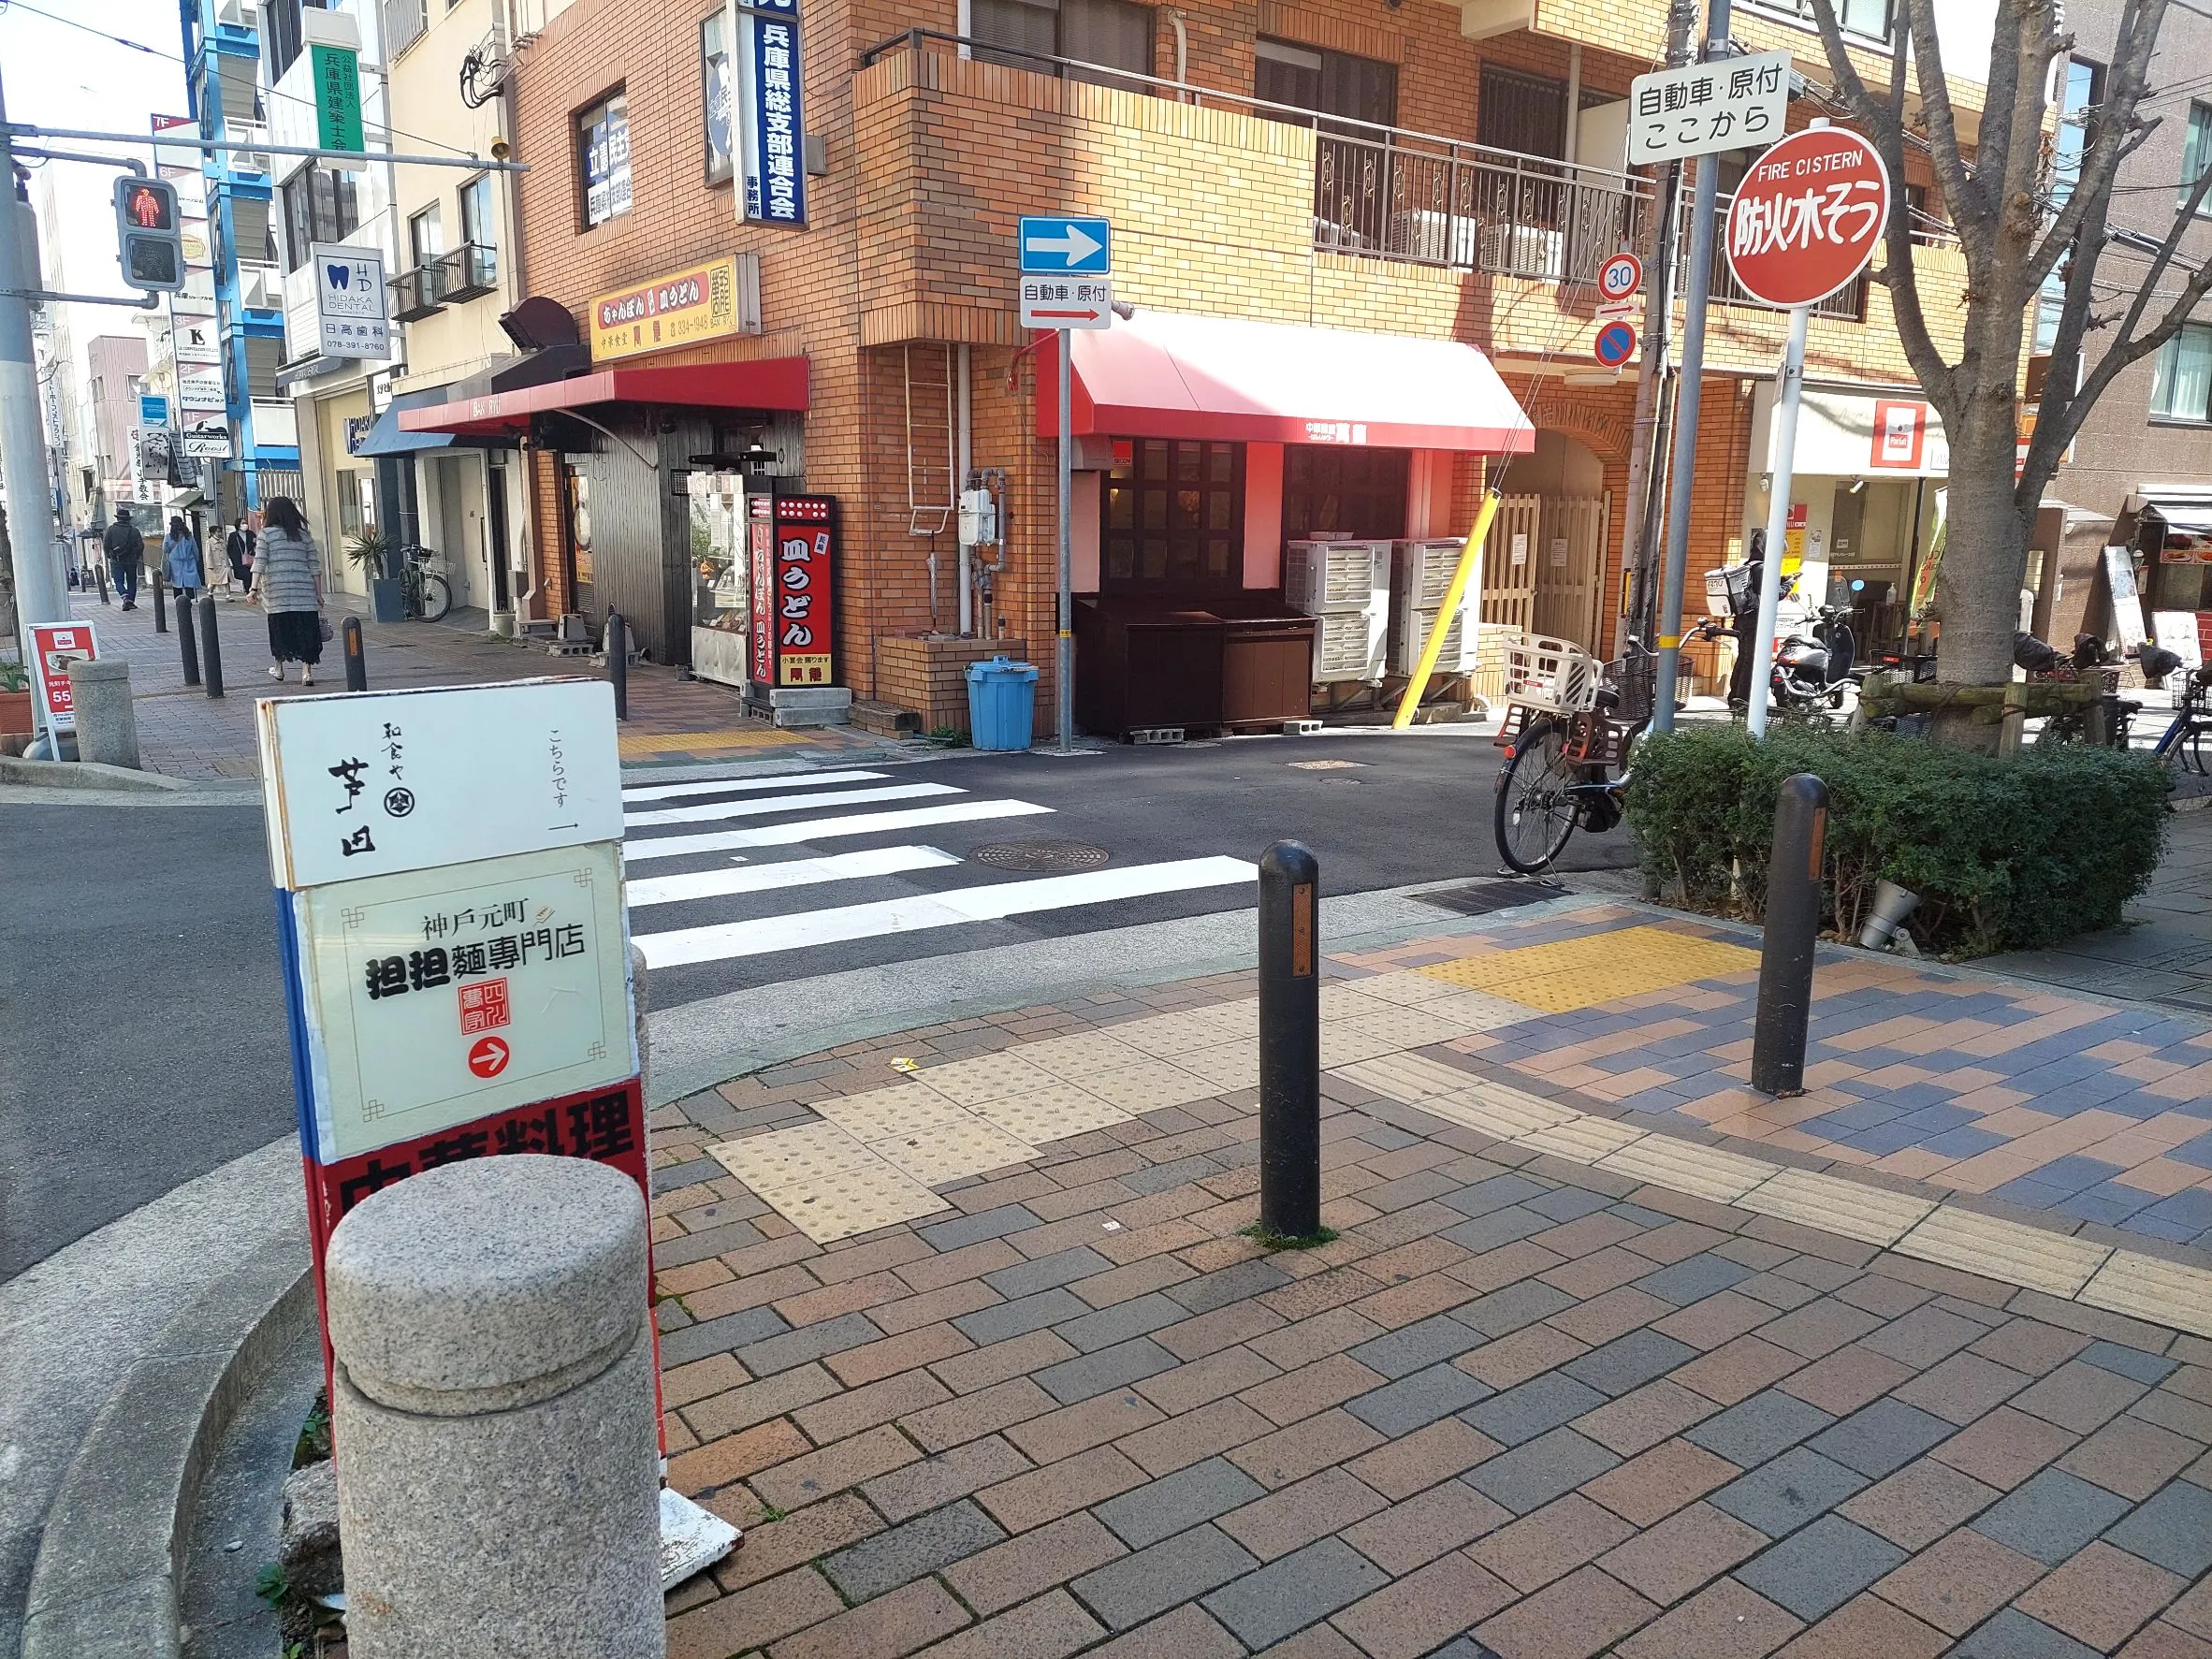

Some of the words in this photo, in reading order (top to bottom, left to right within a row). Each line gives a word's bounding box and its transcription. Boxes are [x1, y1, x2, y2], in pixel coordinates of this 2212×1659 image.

[342, 54, 357, 109] 公益社団法人
[1638, 62, 1784, 117] 自動車・原付
[324, 53, 347, 151] 兵庫県建築士会
[153, 116, 169, 127] 7F
[763, 23, 795, 220] 兵庫県総支部連合会
[1645, 105, 1769, 150] ここから
[159, 167, 176, 177] 6F
[1758, 161, 1792, 182] FIRE
[1796, 149, 1863, 176] CISTERN
[747, 176, 760, 216] 事務所
[1733, 180, 1881, 258] 防火水そう
[1025, 284, 1106, 302] 自動車・原付
[1608, 266, 1632, 288] 30
[327, 294, 373, 304] HIDAKA
[328, 301, 376, 312] DENTAL
[603, 296, 645, 325] ちゃんぽん
[660, 279, 700, 311] 皿うどん
[174, 316, 190, 326] 3F
[326, 323, 384, 337] 日高歯科
[327, 340, 385, 351] 078-391-8760
[180, 364, 195, 373] 2F
[184, 412, 199, 422] 1F
[187, 442, 227, 454] Roost
[782, 539, 812, 646] 皿うどん
[381, 722, 404, 780] 和食や
[548, 729, 568, 808] こちらです
[327, 756, 376, 857] 芦田
[421, 898, 530, 941] 神戸元町
